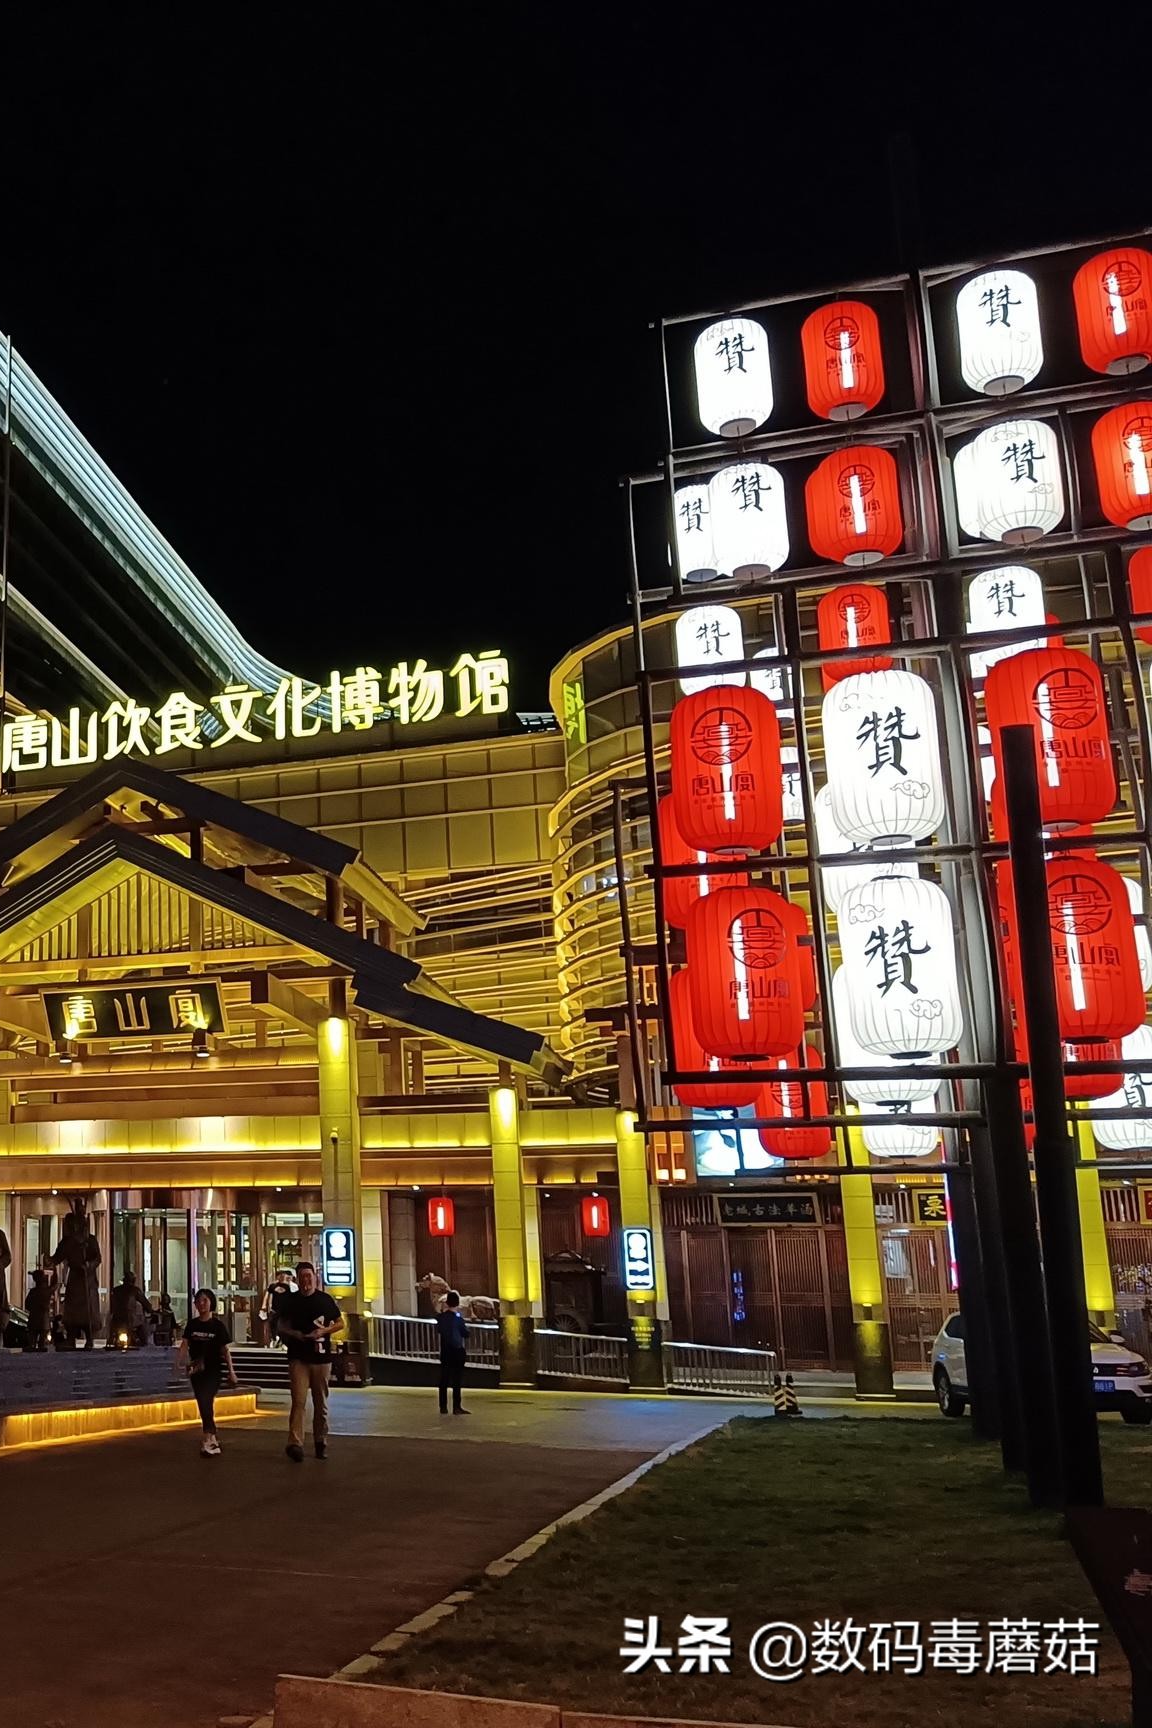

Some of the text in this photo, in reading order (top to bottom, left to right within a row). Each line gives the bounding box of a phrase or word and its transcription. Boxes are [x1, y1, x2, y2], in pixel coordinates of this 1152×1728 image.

[1, 649, 510, 774] 唐山饮食文化博物馆
